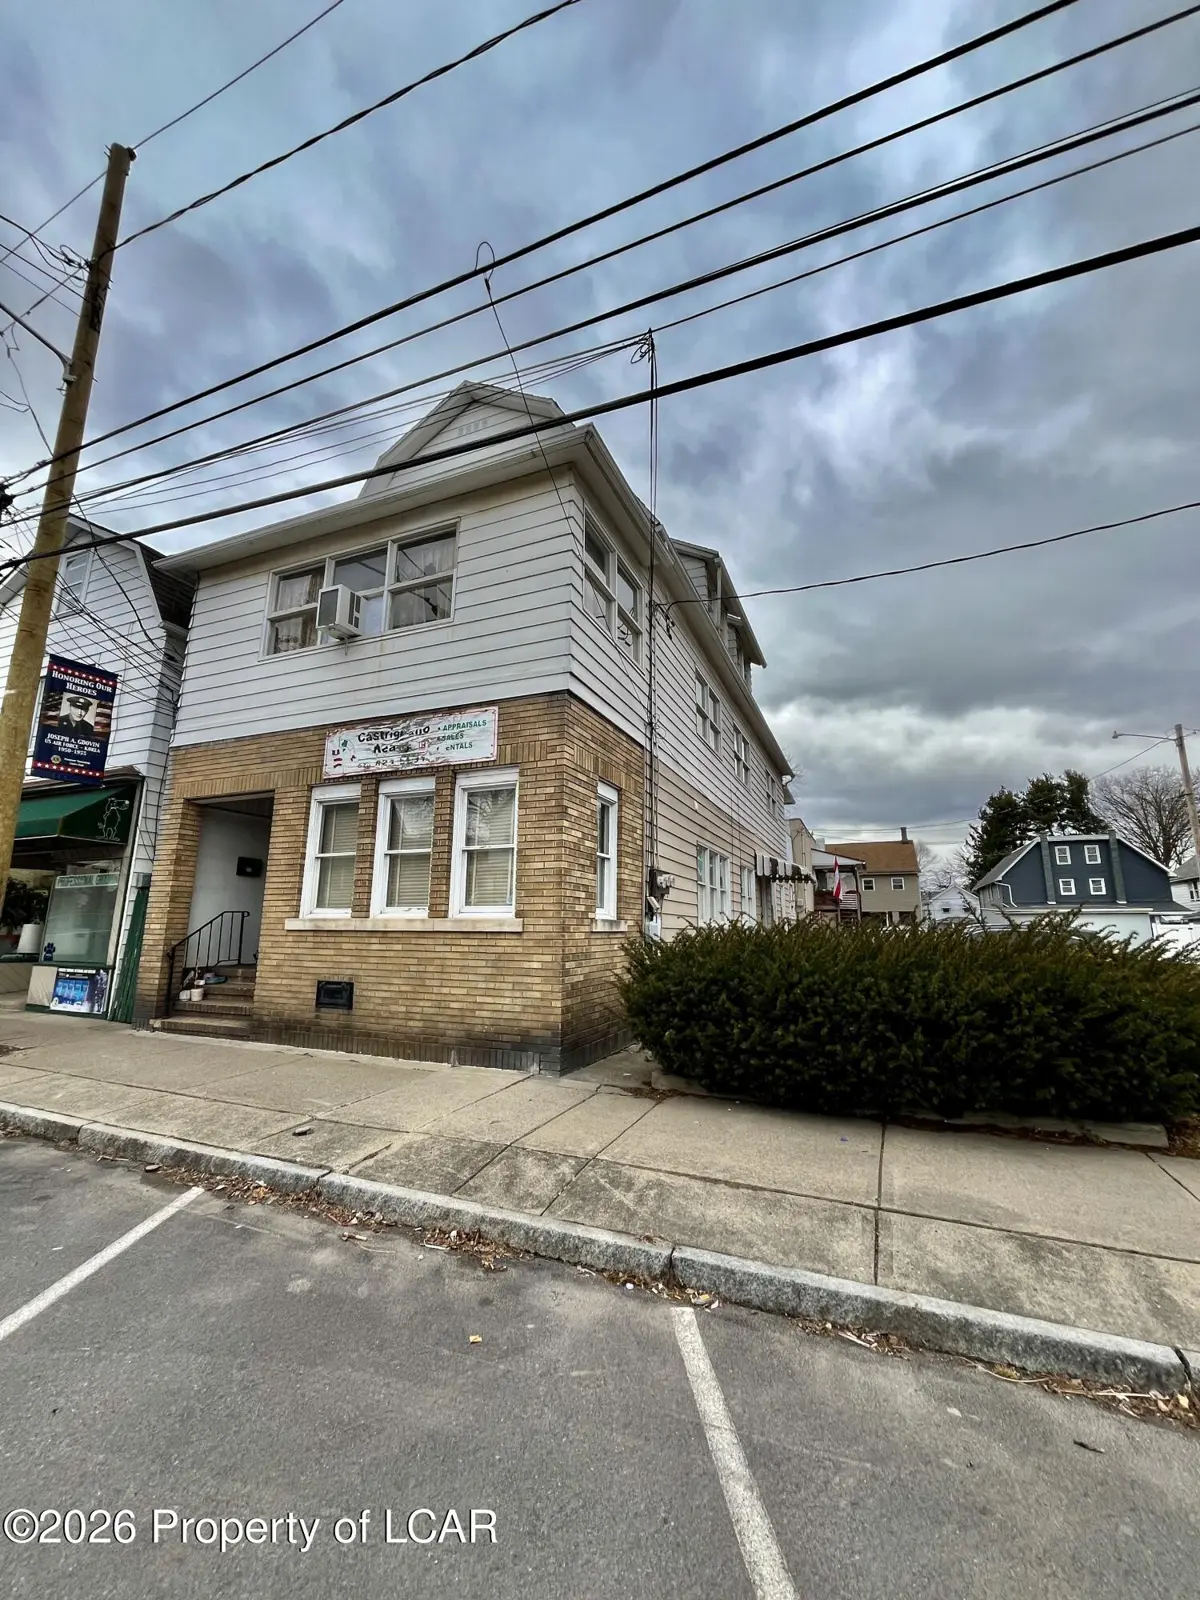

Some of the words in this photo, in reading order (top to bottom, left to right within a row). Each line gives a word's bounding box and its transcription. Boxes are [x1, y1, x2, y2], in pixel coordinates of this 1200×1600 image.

[52, 670, 94, 688] HONORING
[96, 682, 112, 693] OUR
[65, 682, 97, 696] HEROES
[443, 719, 487, 731] APPRAISALS
[47, 733, 70, 742] JOSEPH
